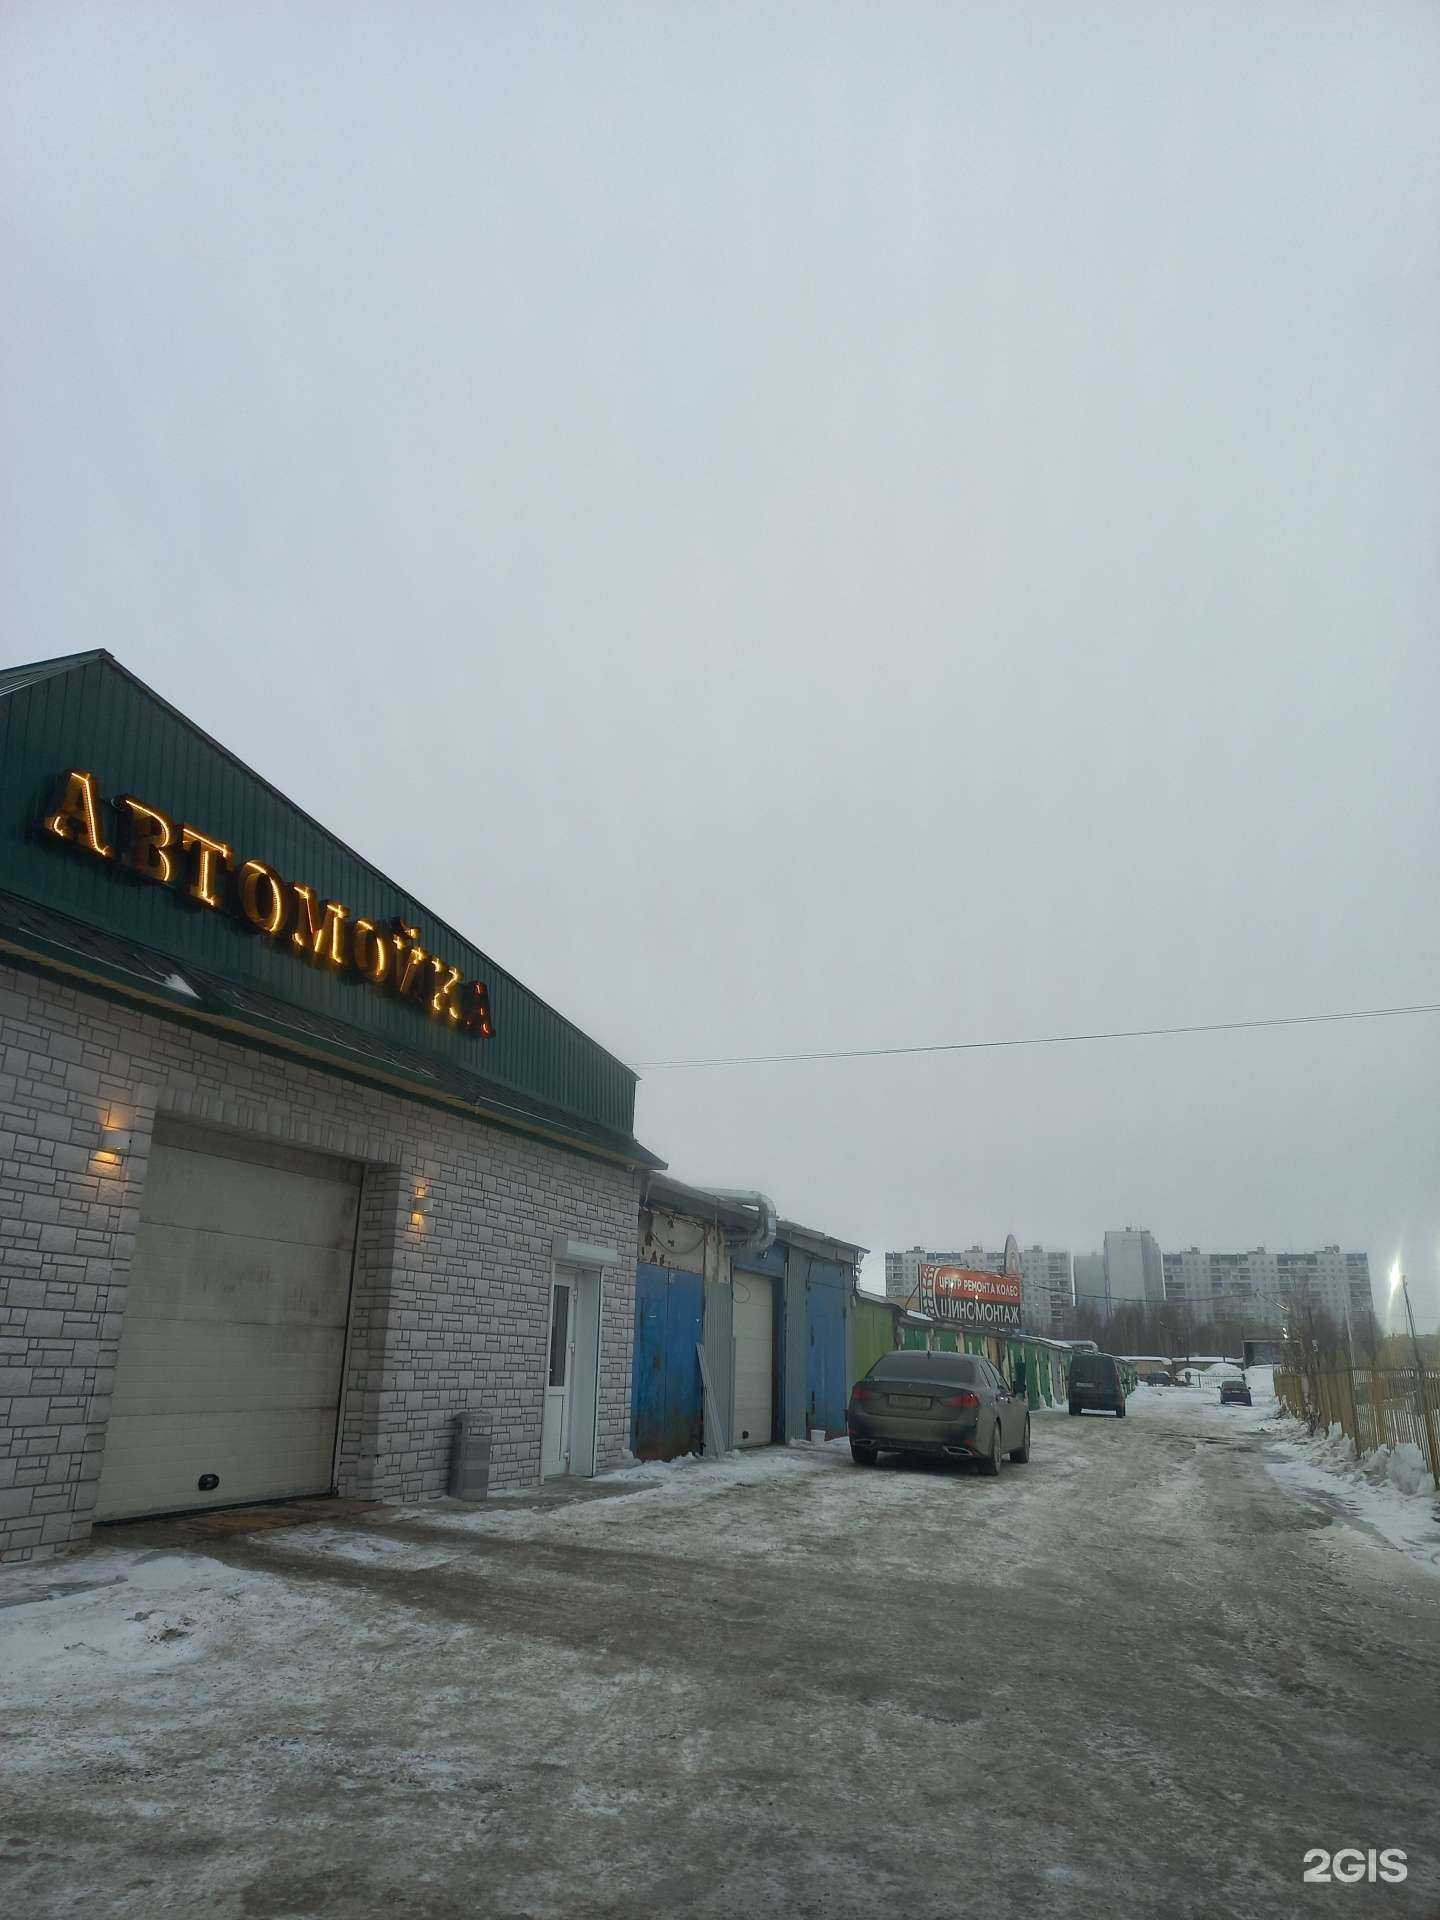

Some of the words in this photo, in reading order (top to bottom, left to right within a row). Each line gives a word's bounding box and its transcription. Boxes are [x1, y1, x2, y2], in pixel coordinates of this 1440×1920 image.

[44, 768, 496, 1039] АВТОМОЙКА
[939, 1276, 962, 1291] ЦЕНТР
[963, 1279, 996, 1295] РЕМОНТА
[996, 1283, 1019, 1297] КОЛЕС
